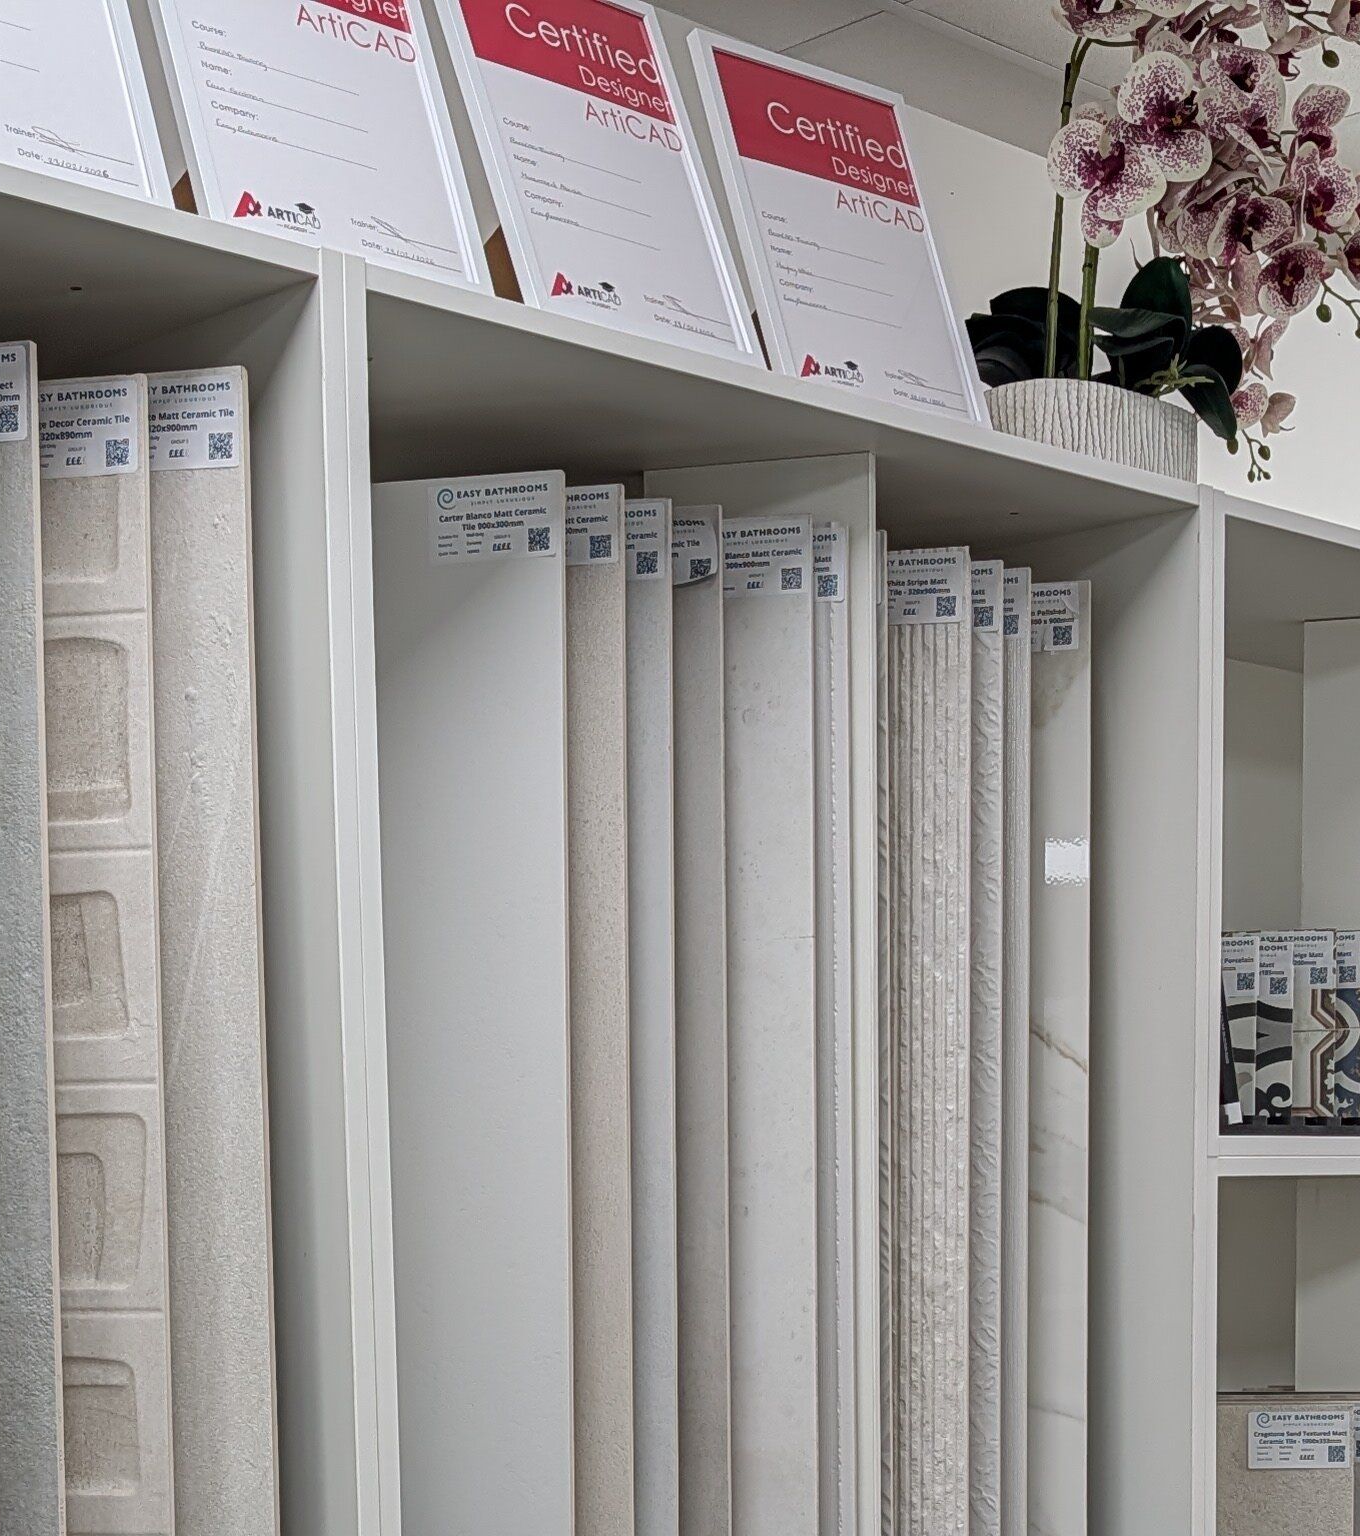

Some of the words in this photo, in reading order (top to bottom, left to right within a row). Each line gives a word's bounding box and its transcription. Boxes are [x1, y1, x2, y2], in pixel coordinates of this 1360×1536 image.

[346, 0, 407, 22] gner
[192, 20, 227, 37] Course:
[297, 4, 416, 63] ArtiCAD
[505, 3, 660, 84] Certified
[578, 65, 671, 116] Designer
[211, 101, 259, 121] Company:
[5, 124, 39, 140] Trainer:
[586, 101, 682, 152] ArtiCAD
[767, 101, 907, 170] Certified
[18, 148, 43, 161] Date:
[832, 156, 915, 198] Designer
[267, 206, 321, 230] ARTICAD
[837, 189, 924, 232] ArtiCAD
[362, 239, 383, 252] Date:
[578, 285, 621, 306] ARTICAD
[57, 388, 128, 402] BATHROOMS
[162, 382, 231, 395] BATHROOMS
[49, 418, 74, 428] Decor
[77, 416, 113, 427] Ceramic
[115, 415, 130, 423] Tile
[158, 412, 179, 421] Matt
[181, 410, 216, 420] Ceramic
[219, 409, 234, 417] Tile
[457, 489, 481, 499] EASY
[484, 484, 548, 496] BATHROOMS
[439, 514, 464, 523] Carter
[465, 512, 492, 521] Blanco
[494, 510, 513, 518] Matt
[515, 507, 546, 516] Ceramic
[576, 515, 608, 523] Ceramic
[462, 523, 476, 531] Tile
[740, 527, 801, 538] BATHROOMS
[626, 532, 658, 540] Ceramic
[771, 548, 802, 556] Ceramic
[898, 557, 957, 567] BATHROOMS
